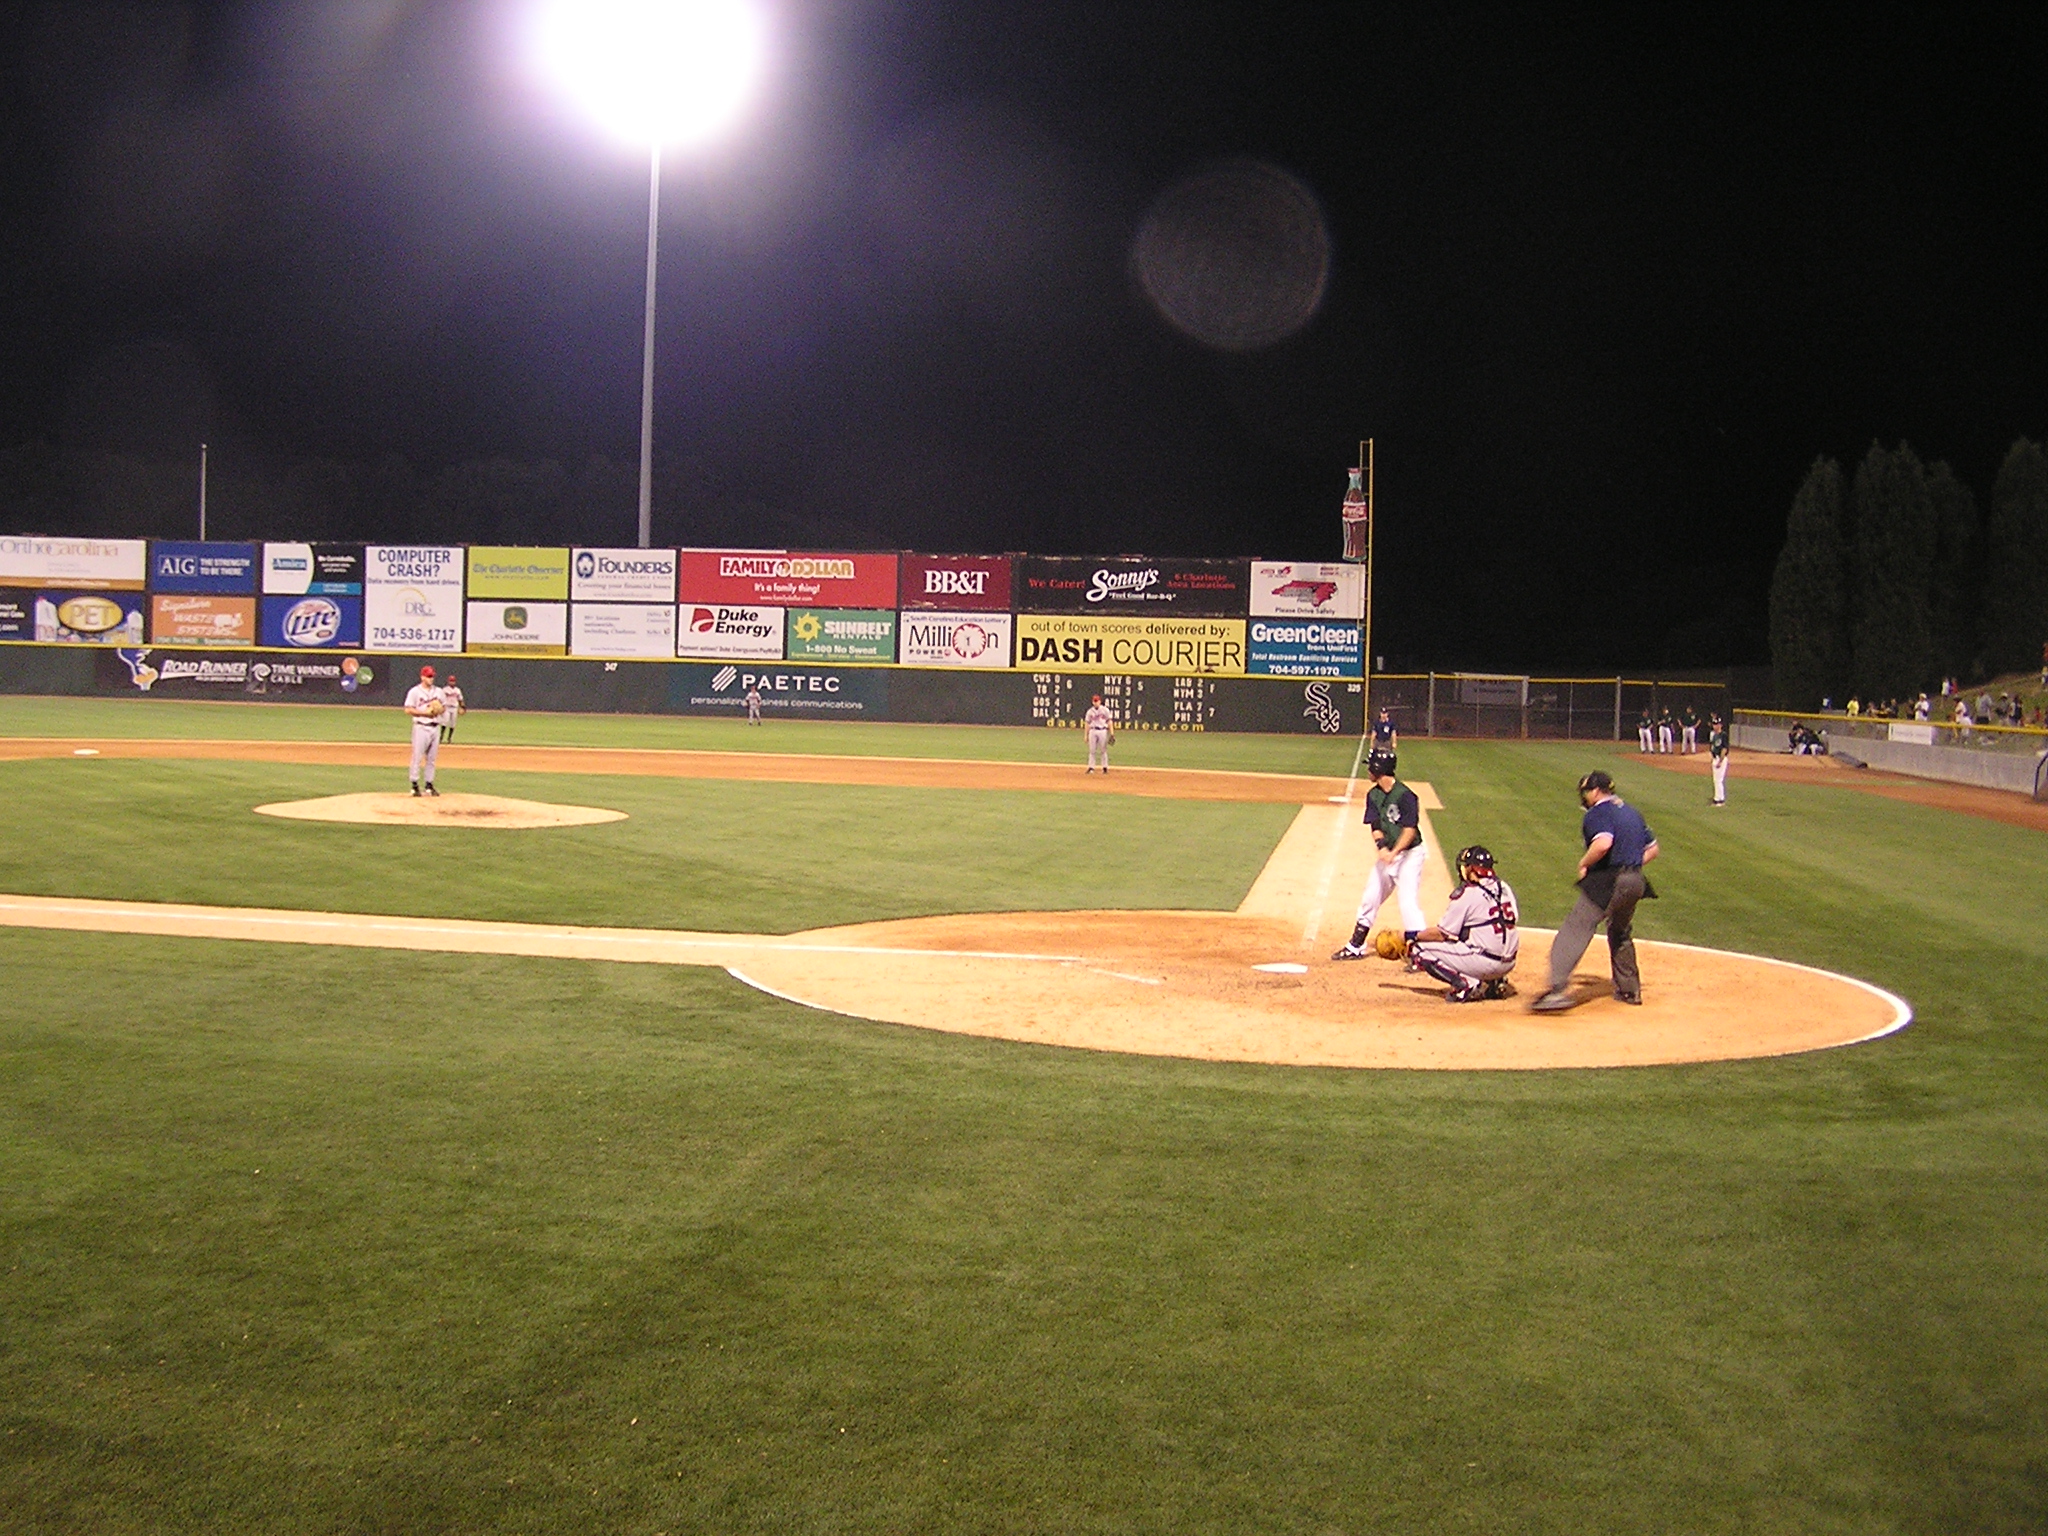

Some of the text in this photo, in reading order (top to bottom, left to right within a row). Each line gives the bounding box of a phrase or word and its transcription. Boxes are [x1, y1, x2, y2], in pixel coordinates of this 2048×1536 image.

[1, 540, 118, 556] OrthoCarolina
[378, 550, 450, 563] COMPUTER
[161, 558, 196, 575] AIG
[388, 564, 440, 577] CRASH?
[721, 558, 854, 577] FAMILY DOLLAR
[773, 583, 797, 594] family
[924, 570, 990, 594] BB&T
[1086, 568, 1160, 602] Sonny's
[70, 605, 115, 626] PET
[718, 608, 759, 622] Duke
[373, 628, 456, 641] 704-536-1717
[715, 622, 773, 638] Energy
[824, 621, 892, 635] SUNBELT
[1031, 621, 1230, 639] out of town scores delivered by:
[1251, 623, 1358, 645] GreenCleen
[834, 646, 847, 654] No
[849, 646, 877, 655] Sweat
[1021, 637, 1241, 668] DASH COURIER
[165, 660, 248, 674] ROAD RUNNER
[271, 664, 341, 676] TIME WARNER
[1269, 665, 1340, 676] 704-597-1970
[742, 674, 841, 692] PAETEC
[1104, 675, 1122, 685] NYY
[1198, 678, 1203, 687] 2
[1054, 685, 1060, 694] 2
[1125, 687, 1132, 696] 3
[1210, 684, 1215, 693] F
[791, 700, 863, 710] communications
[1054, 698, 1060, 707] 4
[1125, 699, 1131, 708] 7
[1174, 702, 1203, 711] FLA 7
[1054, 709, 1060, 718] 3
